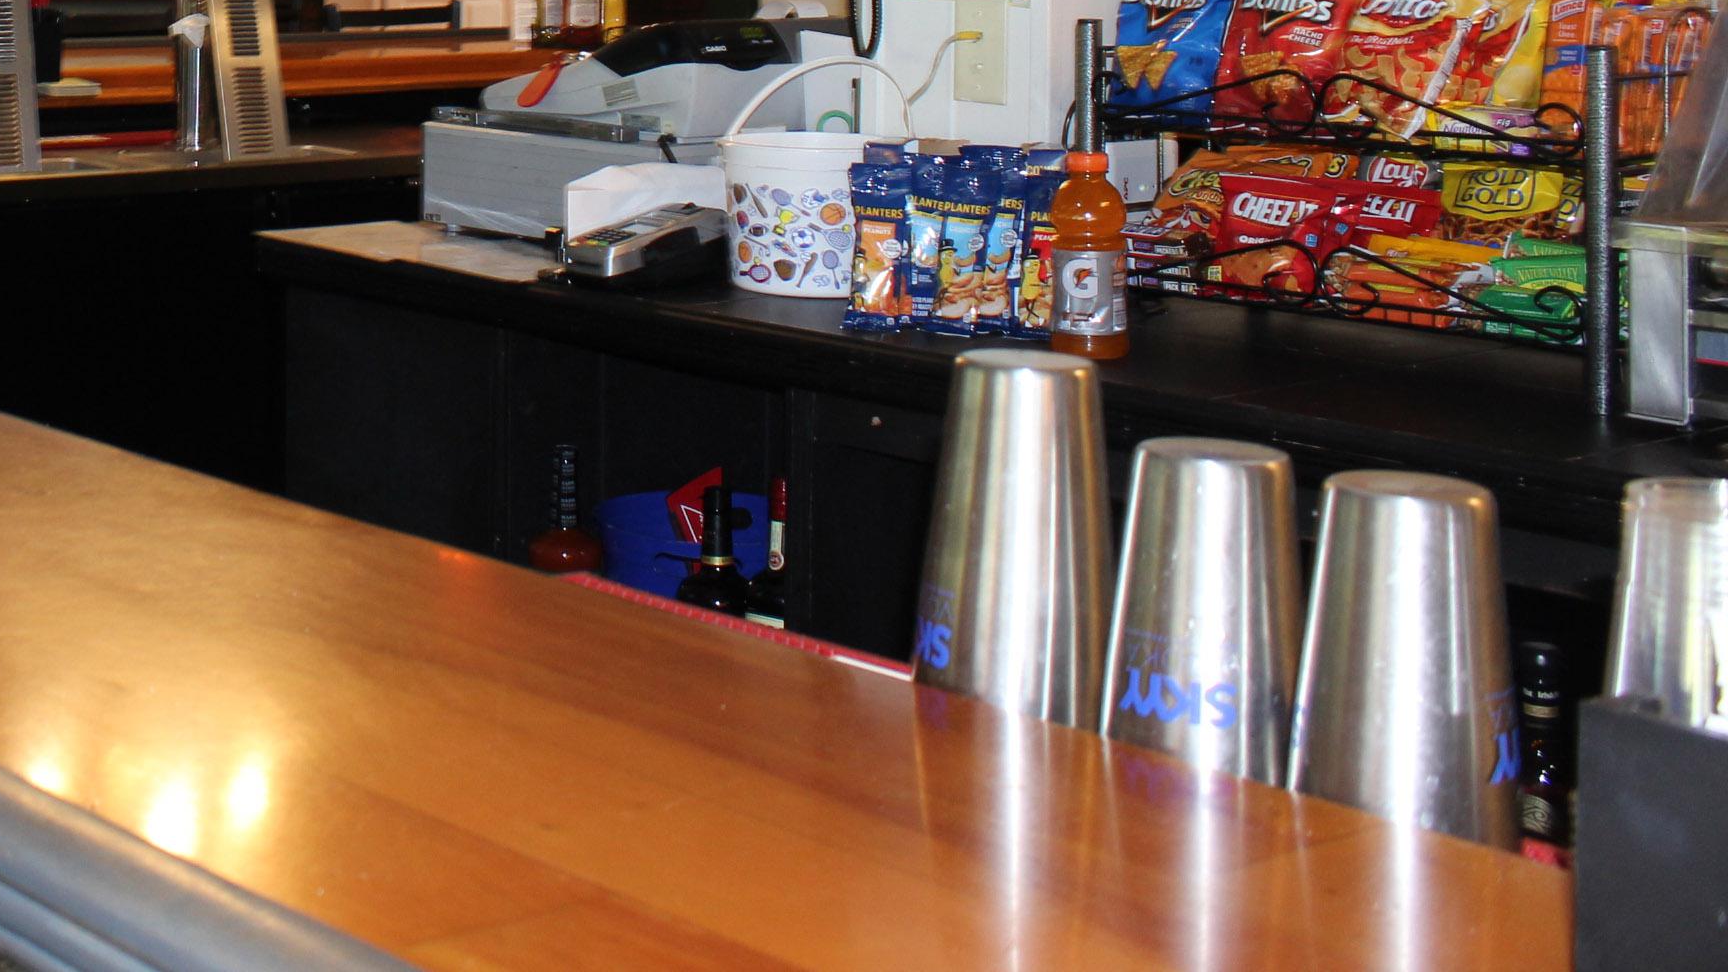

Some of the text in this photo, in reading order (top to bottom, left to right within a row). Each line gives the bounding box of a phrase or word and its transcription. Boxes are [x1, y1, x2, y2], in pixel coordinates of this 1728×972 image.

[1288, 34, 1322, 47] CHEESE
[1292, 28, 1323, 40] NACHO
[1462, 186, 1524, 206] GOLD
[854, 205, 904, 219] PLANTERS
[944, 201, 992, 216] PLANTERS
[1119, 666, 1237, 728] SKYY
